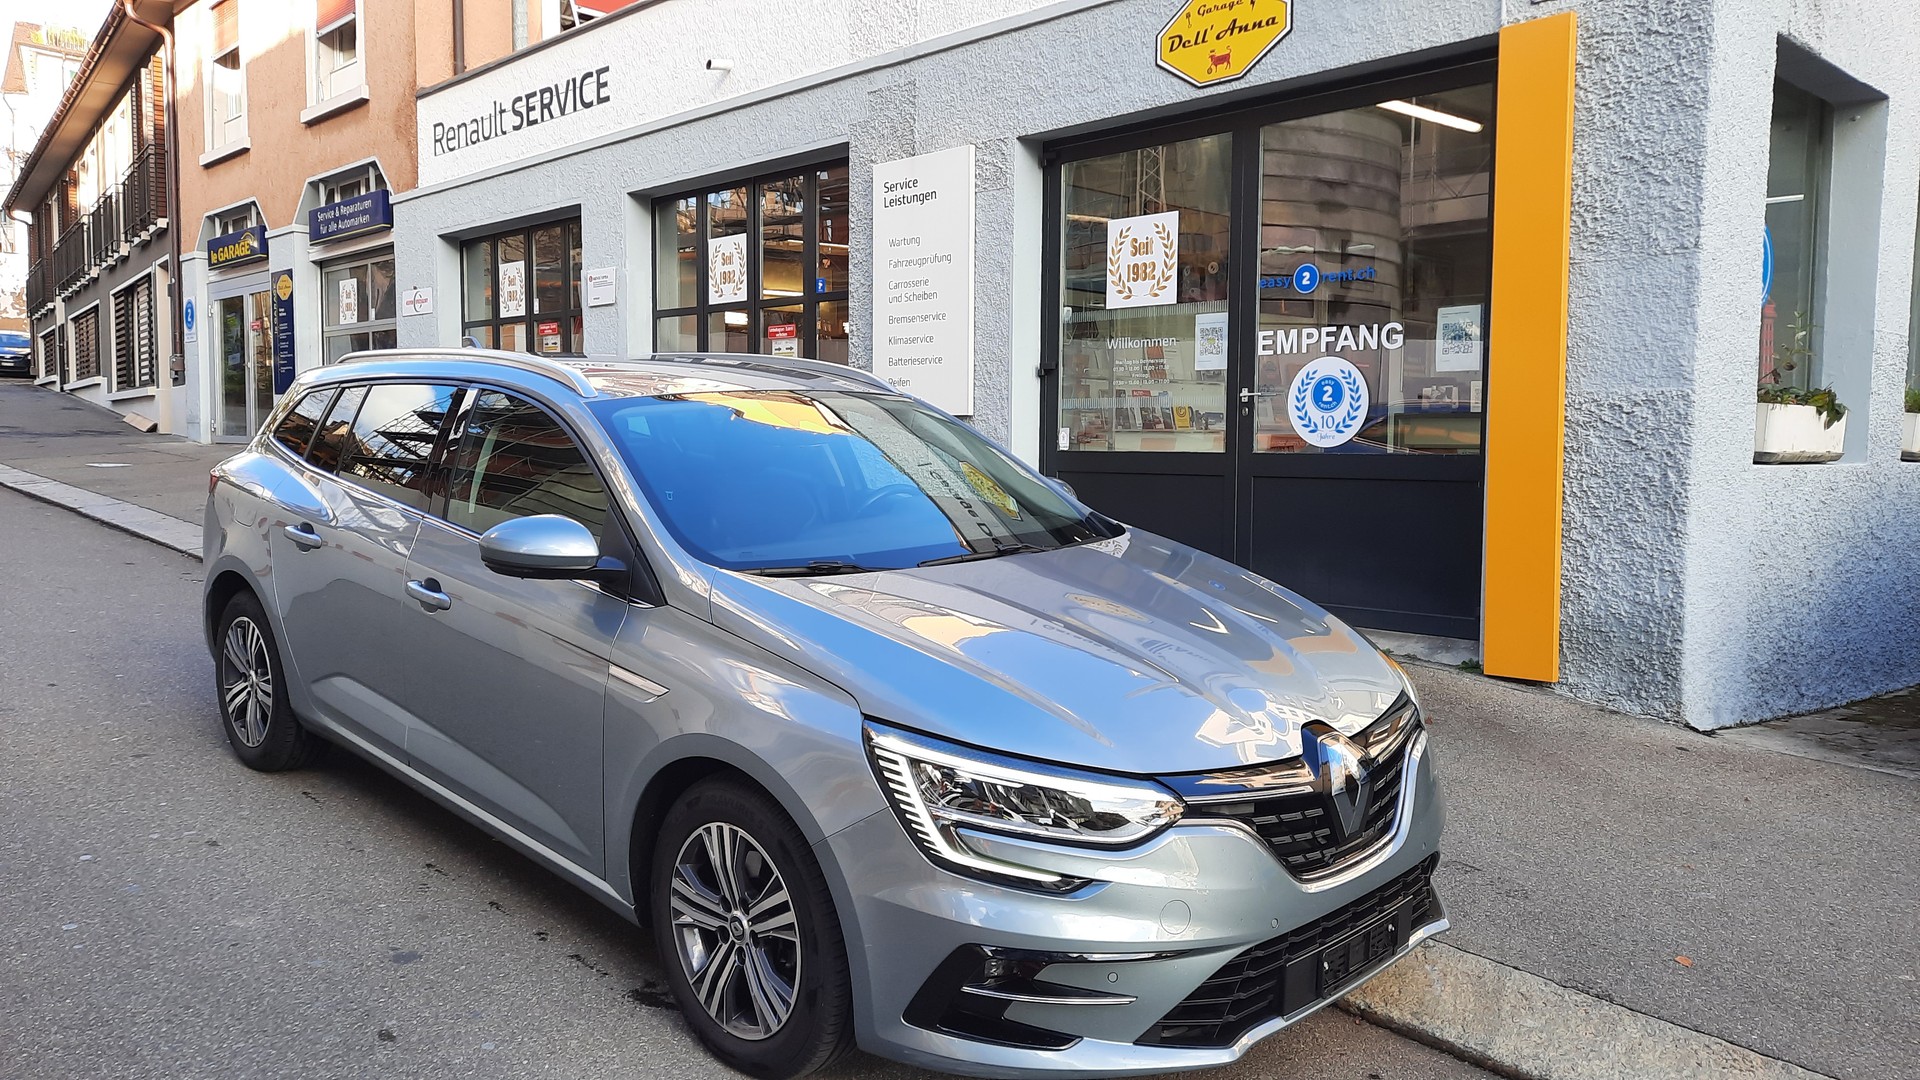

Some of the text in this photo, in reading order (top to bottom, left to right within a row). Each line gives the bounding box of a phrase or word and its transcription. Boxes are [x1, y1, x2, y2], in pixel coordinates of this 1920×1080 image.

[1197, 0, 1244, 17] Garage
[433, 65, 610, 157] Renault SERVICE
[884, 178, 919, 193] Service
[884, 190, 937, 208] Leistungen
[317, 208, 334, 222] Service
[340, 199, 372, 216] Reparaturen
[328, 221, 337, 232] alle
[338, 213, 370, 230] Automarken
[888, 236, 921, 247] Wartung
[1129, 236, 1154, 257] Seit
[211, 240, 251, 264] le GARAGE
[721, 251, 734, 266] Seit
[888, 253, 952, 269] Fahrzeugprüfung
[720, 269, 736, 285] 1982
[1126, 260, 1157, 283] 1982
[1259, 265, 1376, 289] easy 2 rent.ch
[888, 277, 930, 290] Carrosserie
[888, 291, 938, 303] und Scheiben
[888, 312, 947, 325] Bremsenservice
[888, 334, 935, 346] Klimaservice
[1107, 336, 1177, 350] Willkommen
[1257, 321, 1404, 356] EMPFANG
[888, 355, 943, 367] Batterieservice
[888, 377, 911, 388] Reifen
[1322, 385, 1333, 402] 2
[1321, 415, 1335, 429] 10
